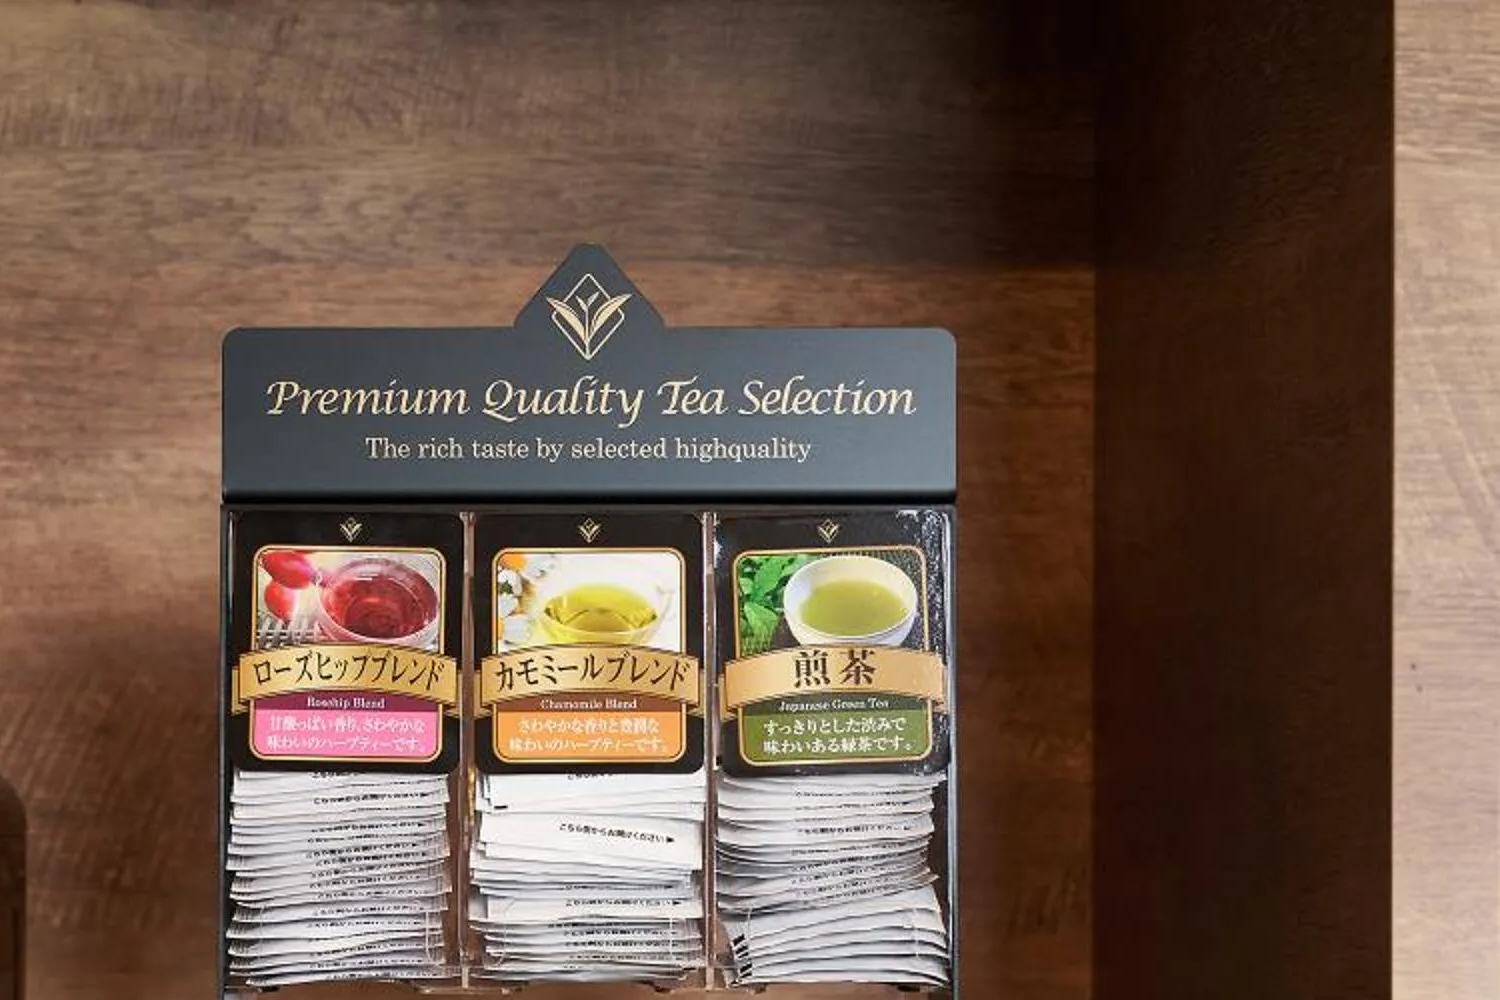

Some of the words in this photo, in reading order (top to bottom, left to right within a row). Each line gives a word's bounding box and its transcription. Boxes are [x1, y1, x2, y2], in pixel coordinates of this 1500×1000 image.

[265, 377, 471, 416] Premium
[481, 375, 645, 429] Quality
[656, 375, 729, 416] Tea
[738, 375, 917, 416] Selection
[365, 436, 412, 459] The
[417, 436, 464, 459] rich
[471, 439, 530, 459] taste
[536, 437, 564, 463] by
[571, 436, 667, 459] selected
[674, 436, 812, 464] highquality
[252, 649, 445, 691] ローズヒップブレンド
[494, 650, 691, 691] カモミールブレンド
[794, 648, 876, 688] 煎茶
[306, 696, 351, 710] Rosehip
[353, 697, 386, 709] Blend
[605, 698, 638, 709] Blend
[778, 701, 831, 713] Japanese
[831, 699, 866, 710] Green
[867, 697, 890, 708] Tea
